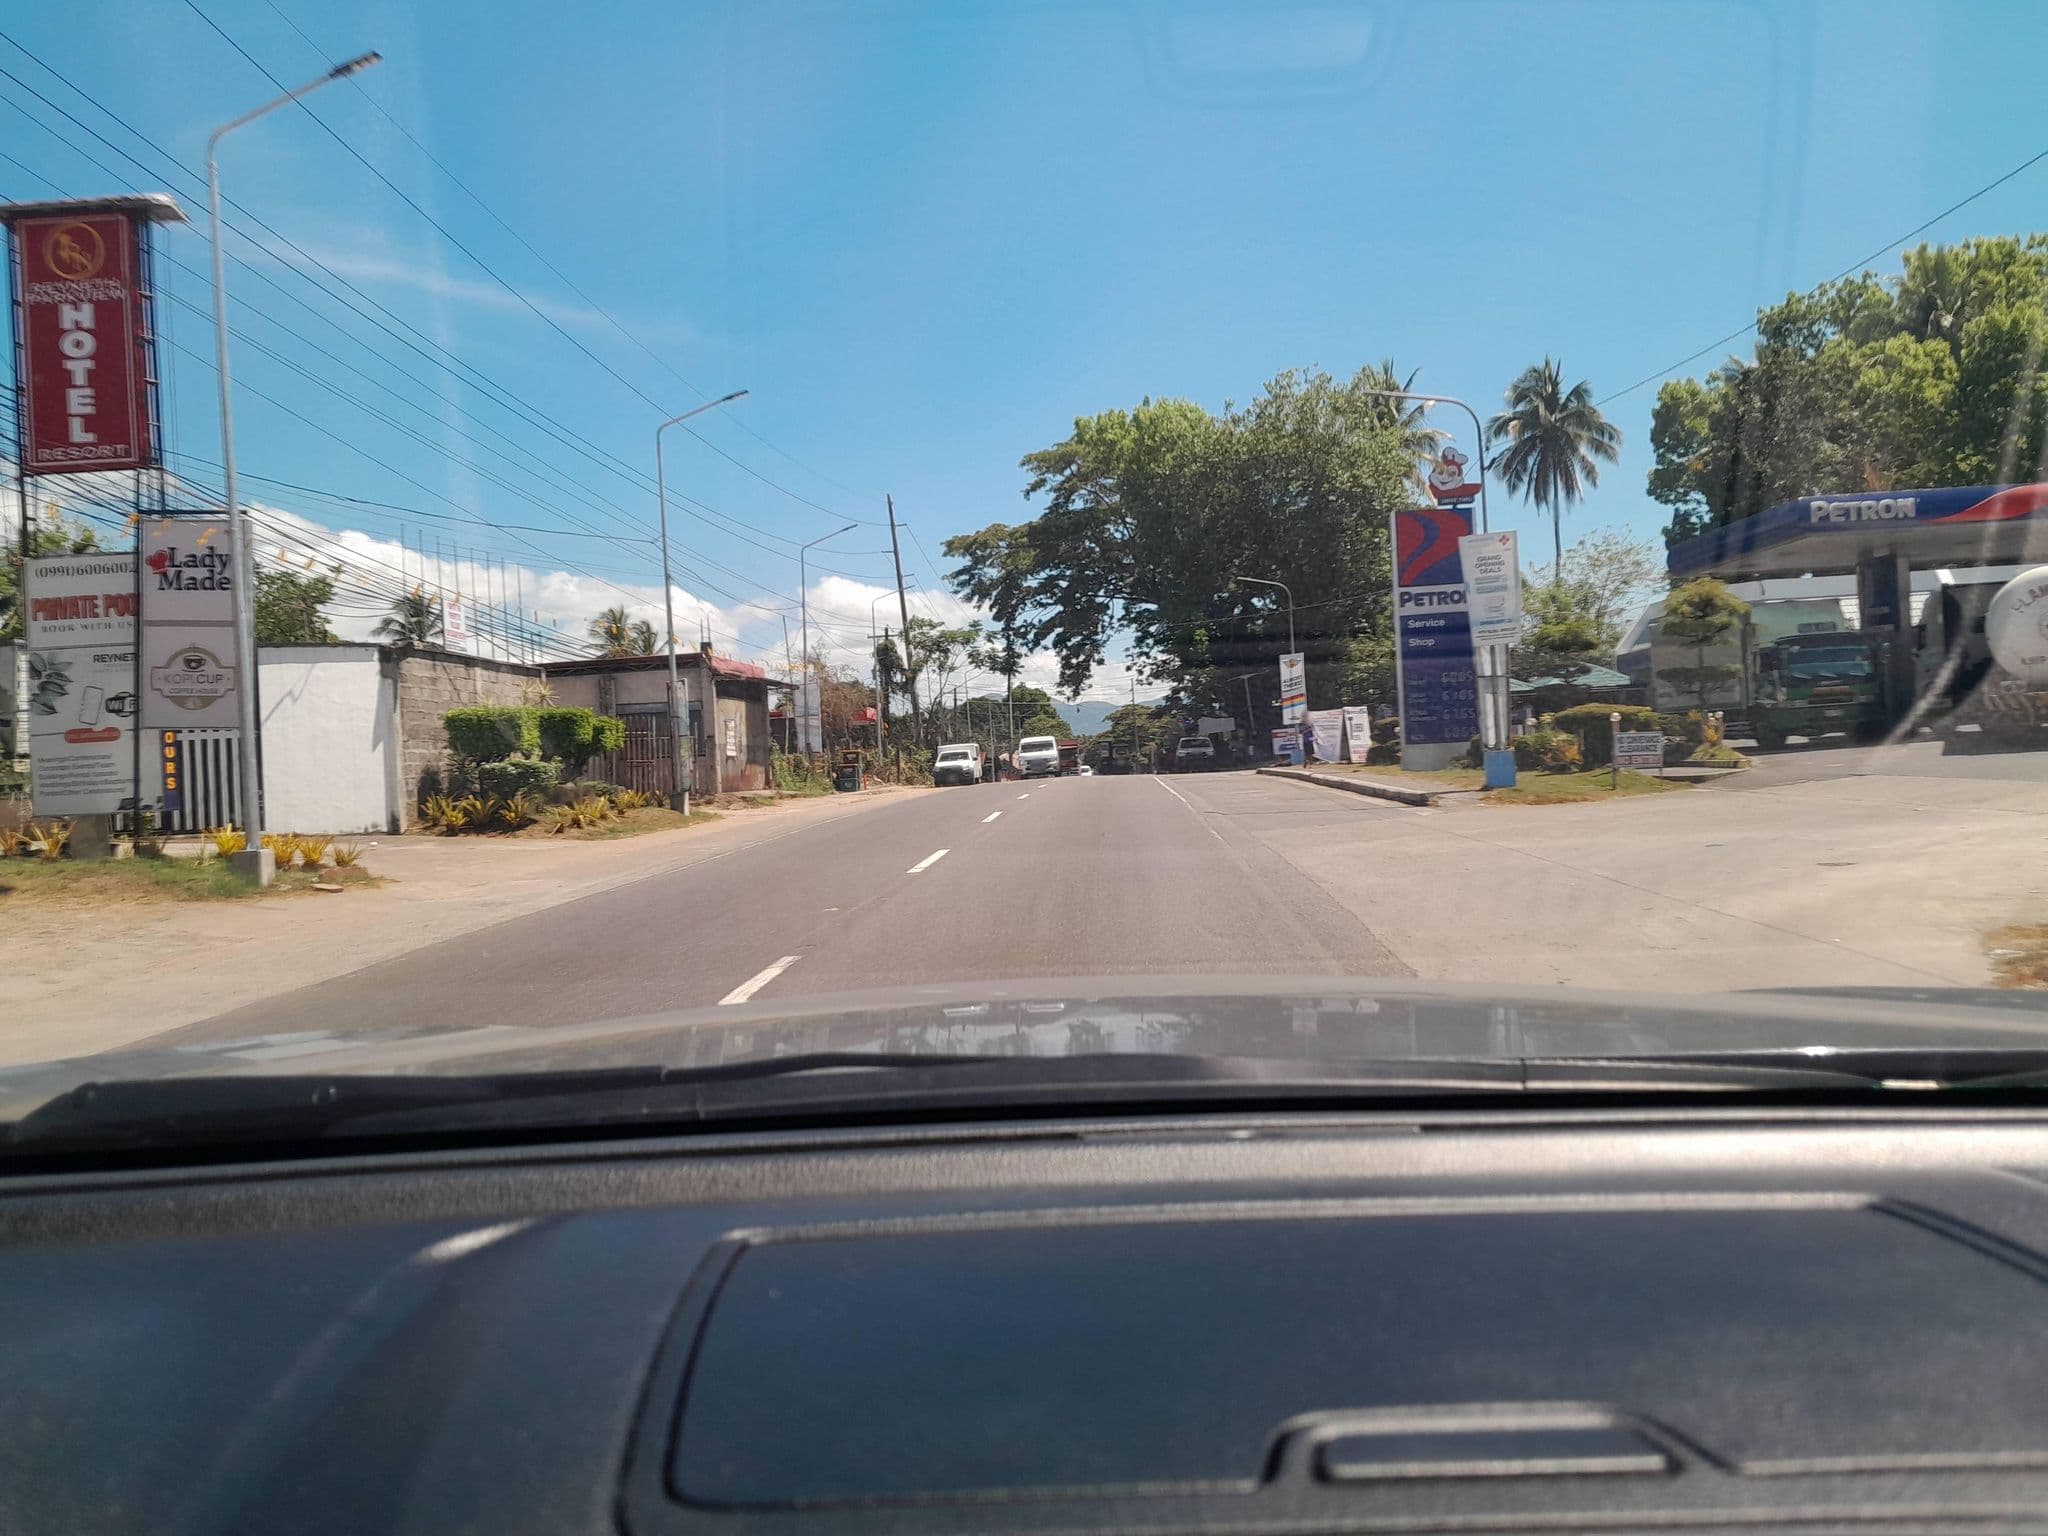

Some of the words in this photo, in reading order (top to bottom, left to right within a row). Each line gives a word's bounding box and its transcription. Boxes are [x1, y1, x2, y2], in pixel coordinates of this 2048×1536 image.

[58, 302, 97, 443] HOTEL
[37, 444, 129, 461] RESORT
[1810, 497, 1916, 524] PETRON
[167, 545, 232, 575] Lady
[157, 569, 233, 591] Made
[32, 595, 99, 621] PRIVATE
[103, 593, 138, 617] POO
[1400, 590, 1467, 608] PETRO
[1407, 619, 1445, 629] Service
[1407, 637, 1435, 647] Shop
[164, 731, 176, 790] OURS
